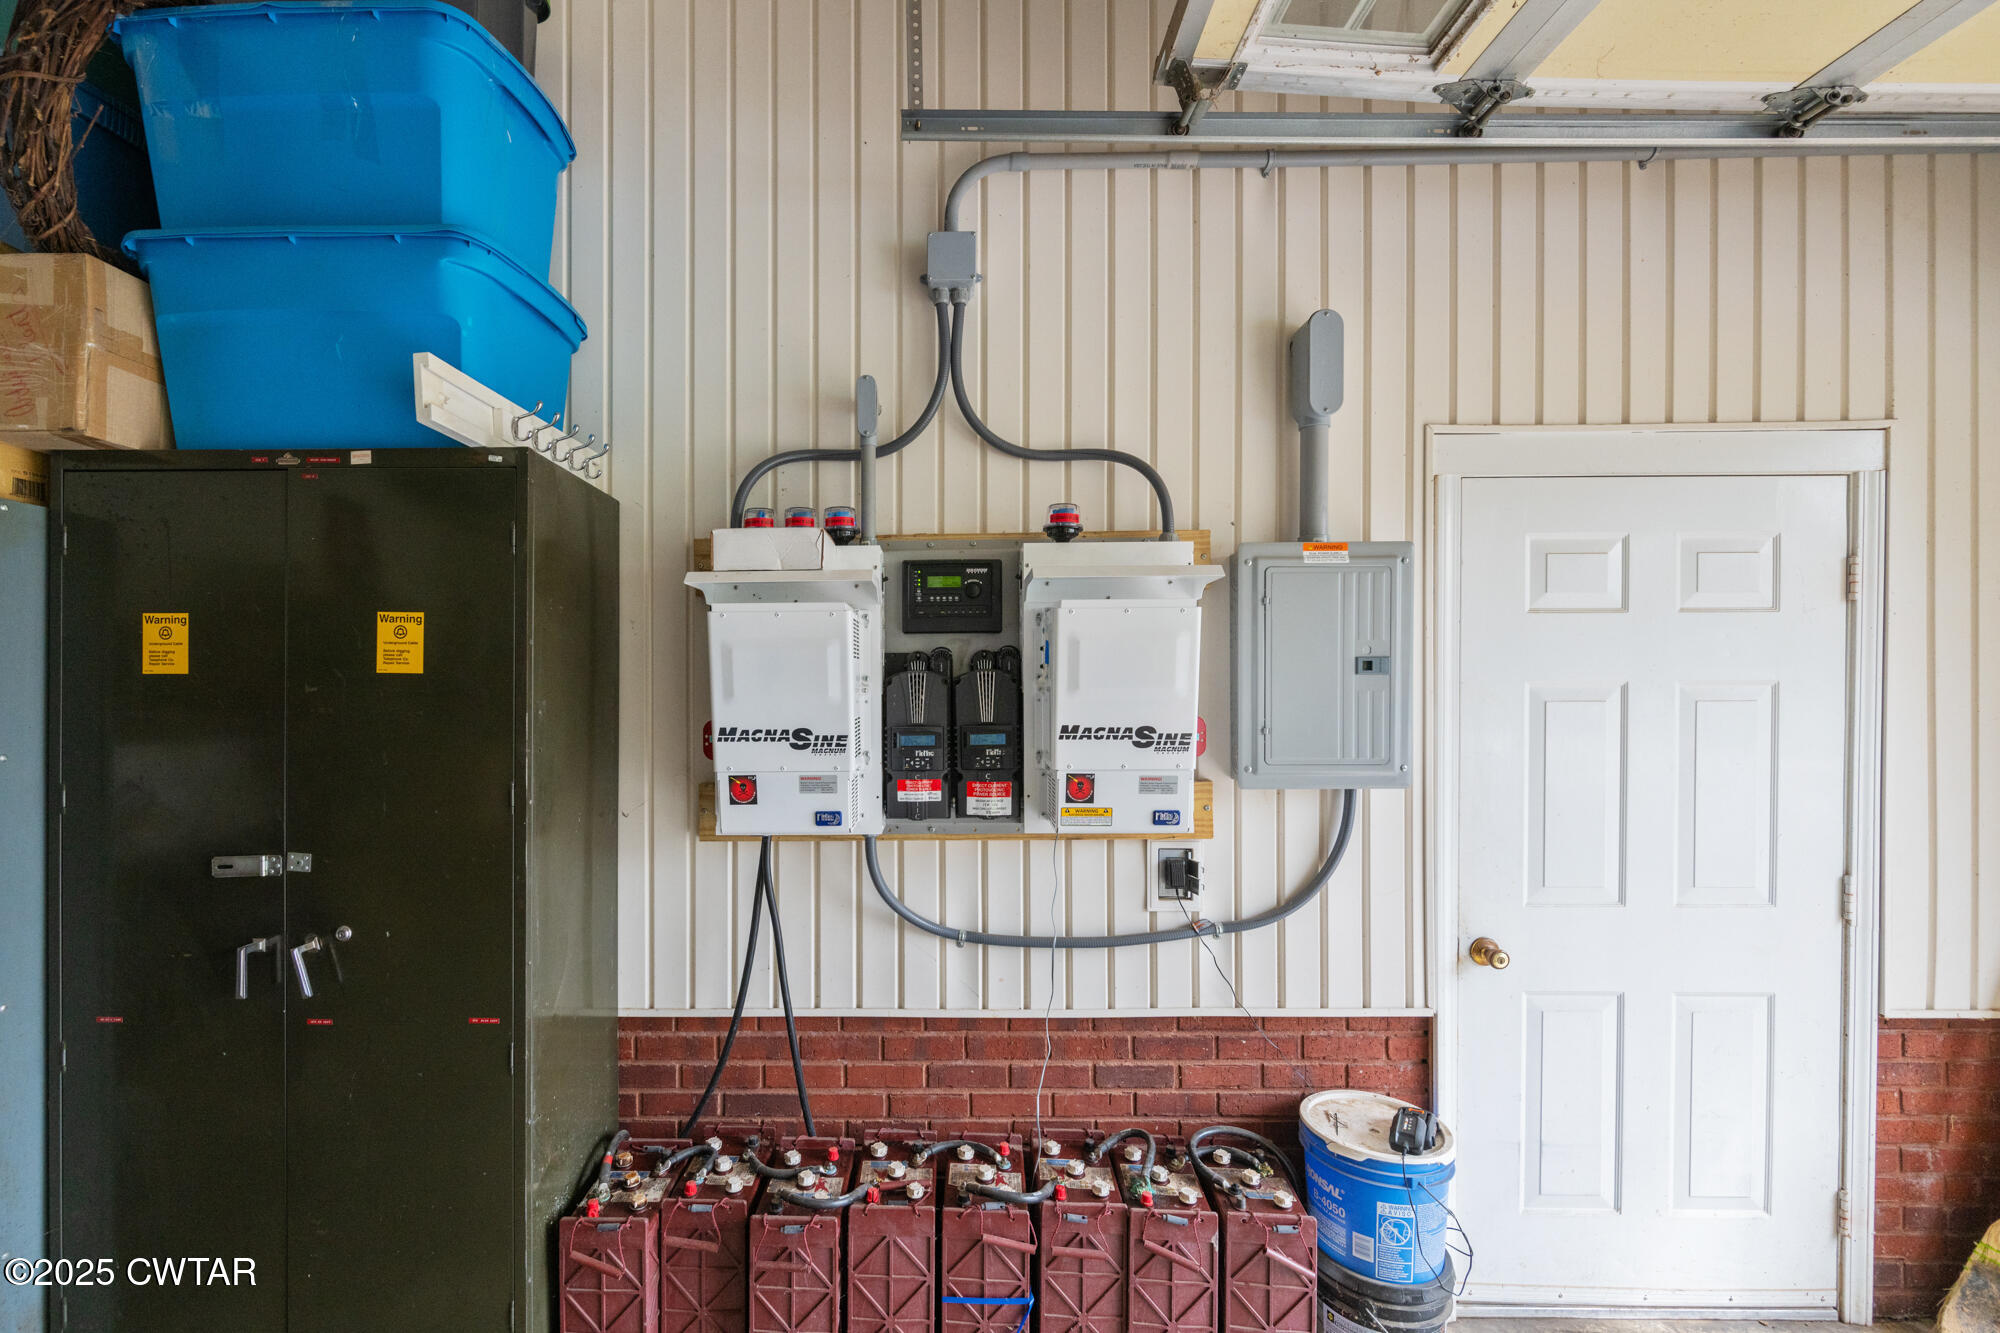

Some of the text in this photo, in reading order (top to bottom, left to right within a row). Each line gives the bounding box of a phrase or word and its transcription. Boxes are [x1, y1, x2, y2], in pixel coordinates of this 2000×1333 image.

[144, 615, 187, 627] Warning
[379, 613, 423, 626] Warning
[1388, 1204, 1412, 1212] WARNIN
